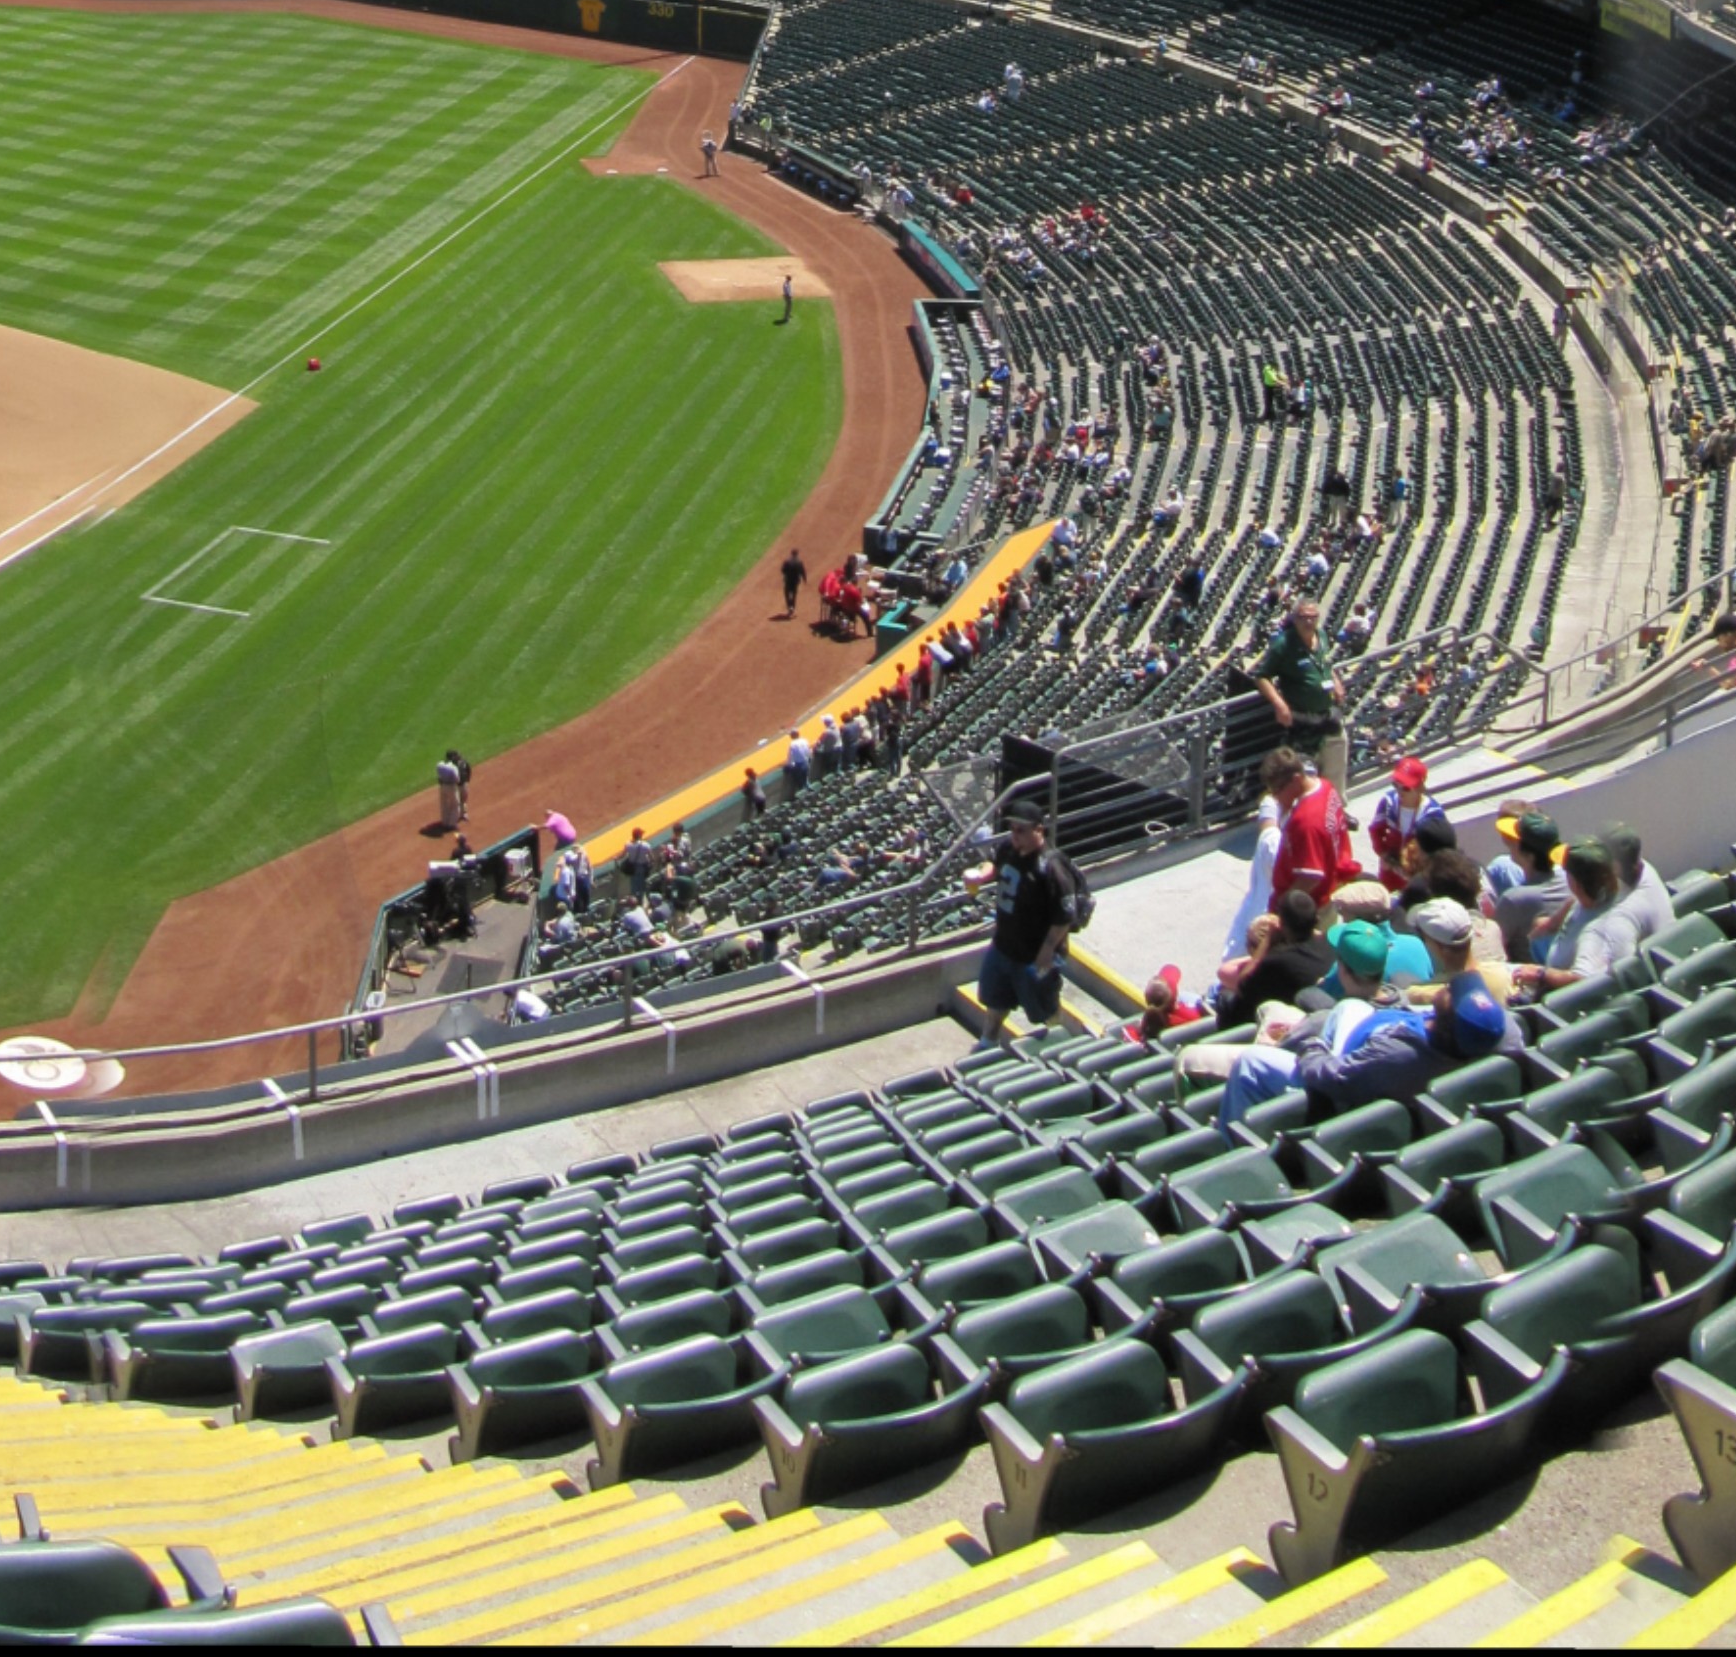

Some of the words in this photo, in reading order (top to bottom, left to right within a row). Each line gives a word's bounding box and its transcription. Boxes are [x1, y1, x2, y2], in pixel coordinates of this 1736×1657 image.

[648, 3, 675, 18] 330
[1011, 1462, 1027, 1488] 11
[1306, 1471, 1330, 1501] 12
